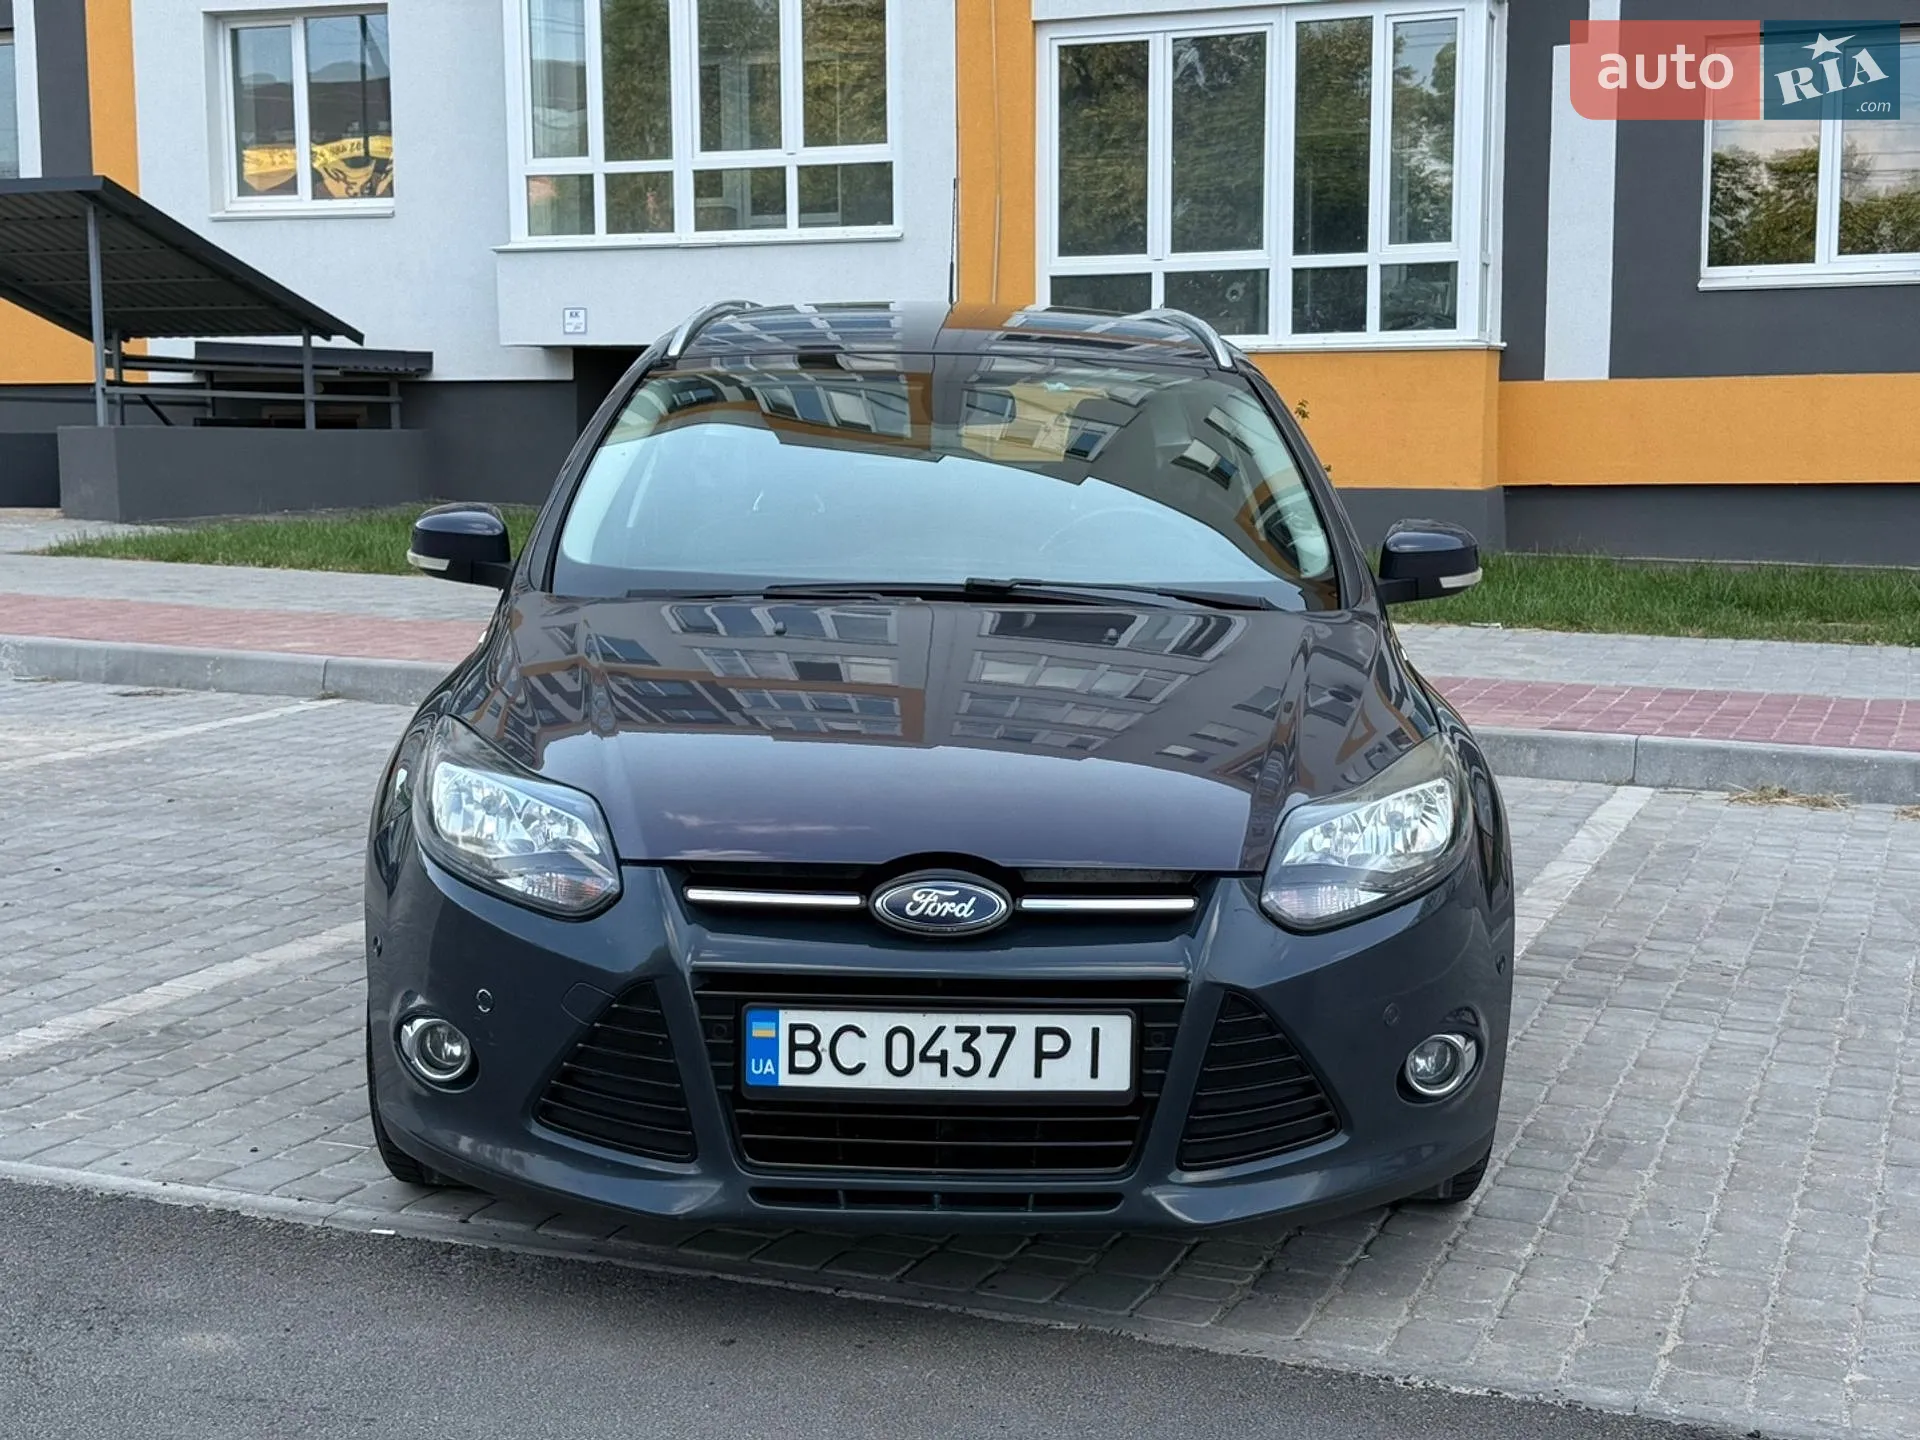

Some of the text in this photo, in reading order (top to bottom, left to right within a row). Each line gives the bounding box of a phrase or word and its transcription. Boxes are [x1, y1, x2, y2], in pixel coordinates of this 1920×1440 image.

[905, 888, 977, 918] Ford
[787, 1022, 867, 1076] BC
[884, 1025, 1017, 1079] 0437
[751, 1058, 775, 1075] UA
